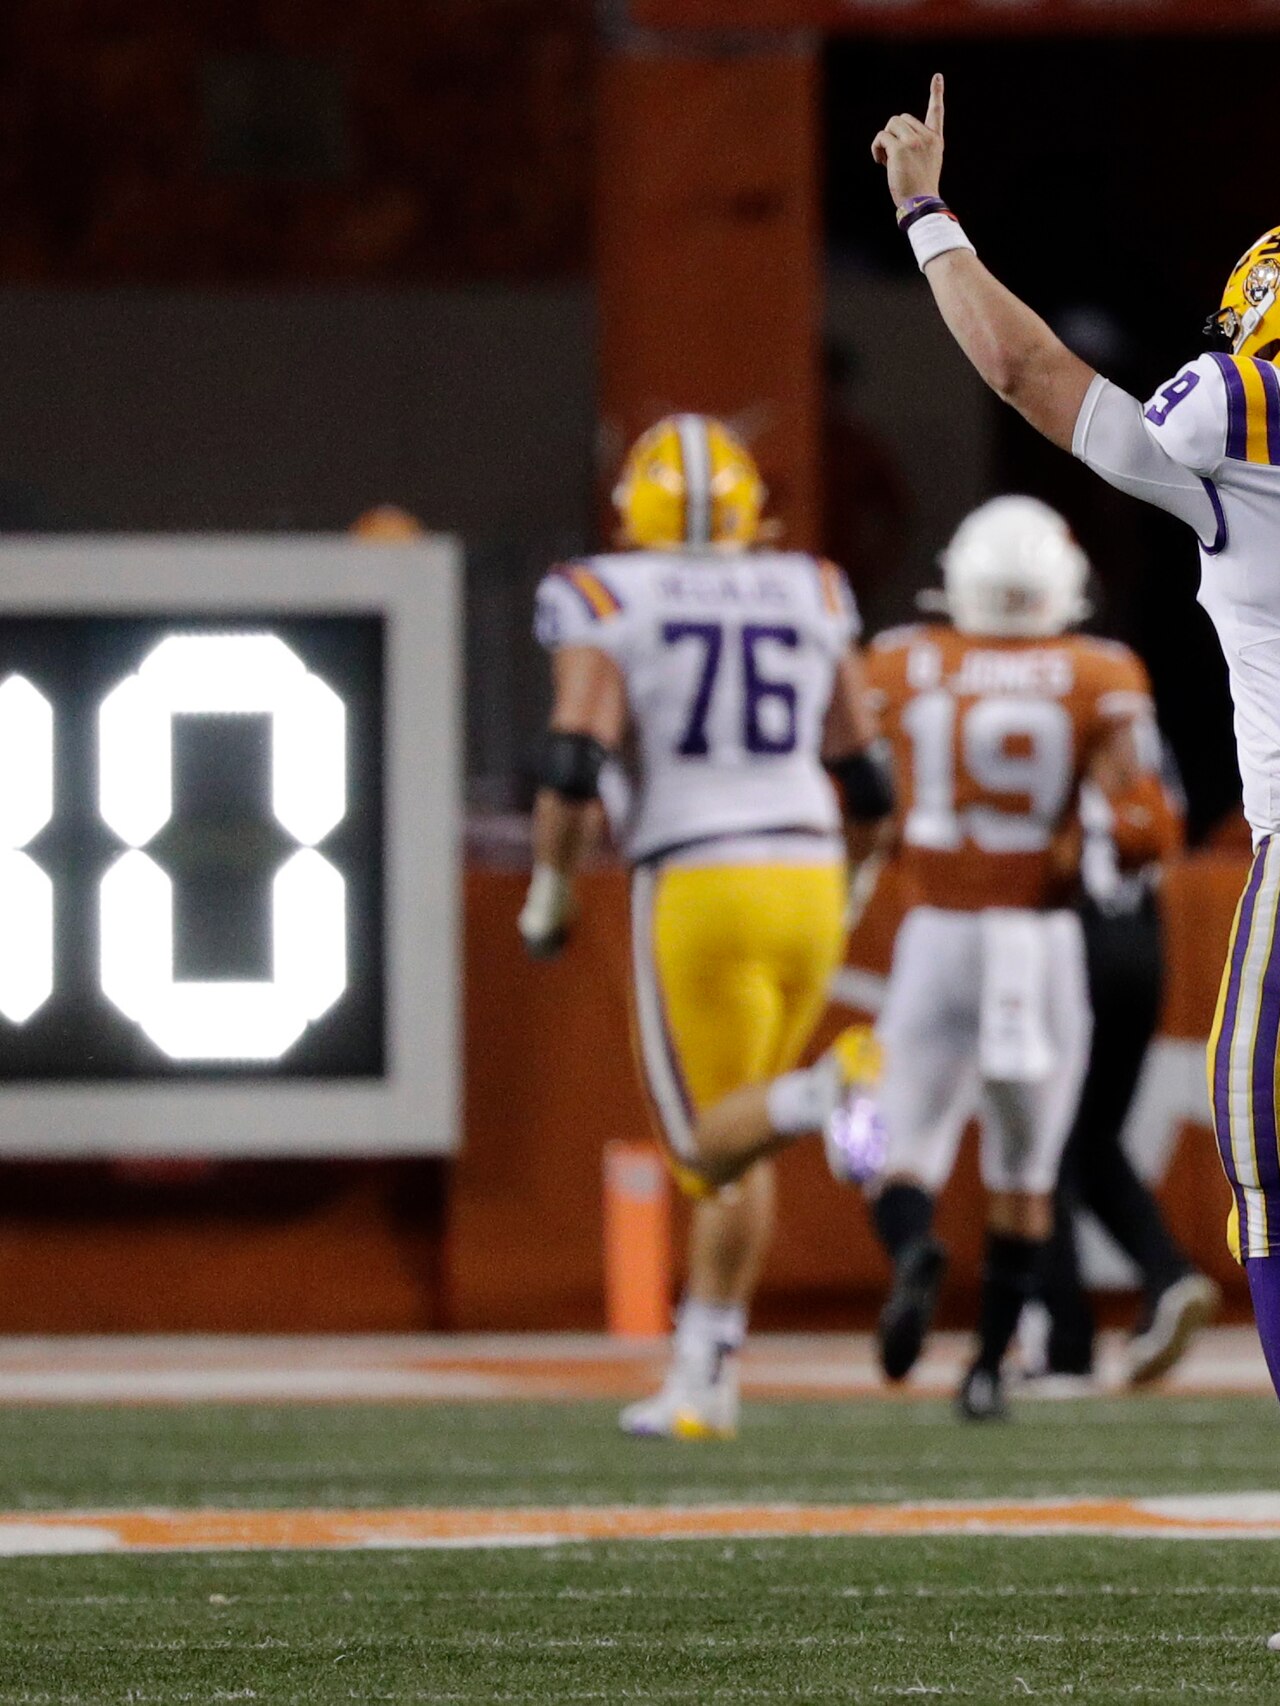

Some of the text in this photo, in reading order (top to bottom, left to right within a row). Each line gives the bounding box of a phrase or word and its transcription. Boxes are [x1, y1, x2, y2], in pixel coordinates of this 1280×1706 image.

[1144, 370, 1200, 427] 9
[662, 622, 797, 755] 76
[903, 692, 1072, 853] 19
[0, 632, 346, 1061] 0
